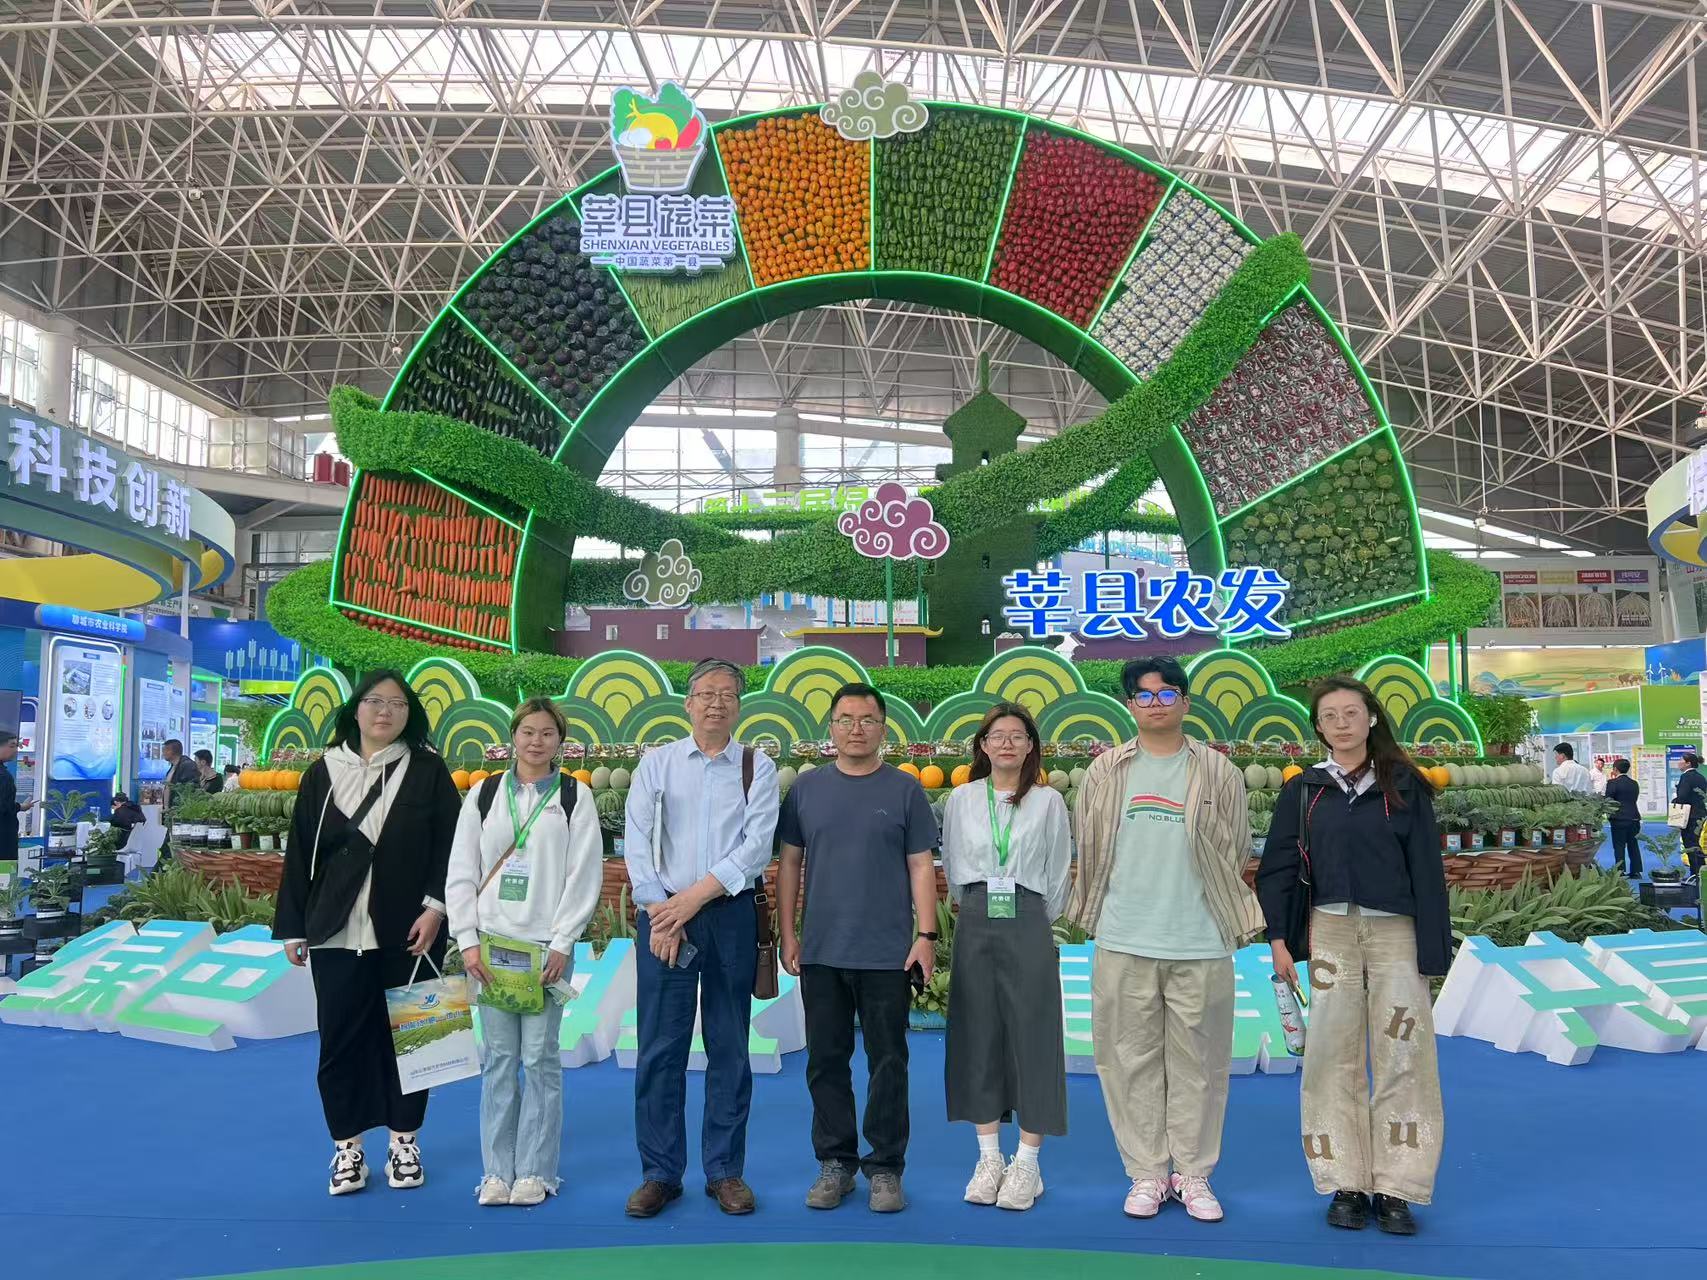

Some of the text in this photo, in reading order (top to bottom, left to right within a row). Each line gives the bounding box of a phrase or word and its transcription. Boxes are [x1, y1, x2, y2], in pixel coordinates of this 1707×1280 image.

[583, 196, 731, 238] 莘县蔬菜
[583, 239, 730, 252] SHENXIAN VEGETABLES
[615, 256, 697, 267] 中国蔬菜第一县
[9, 417, 191, 541] 科技创新
[1003, 567, 1291, 638] 莘县农发
[72, 614, 128, 634] 聊城市农业科学院
